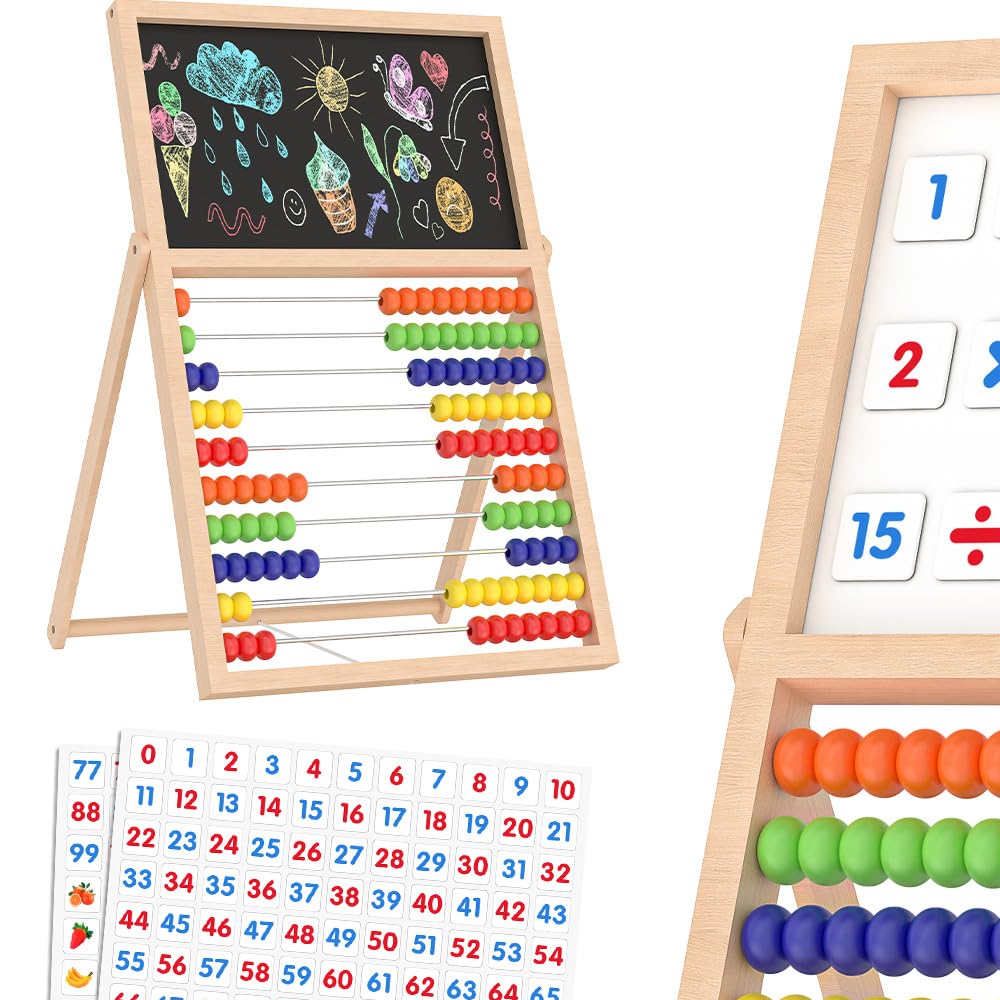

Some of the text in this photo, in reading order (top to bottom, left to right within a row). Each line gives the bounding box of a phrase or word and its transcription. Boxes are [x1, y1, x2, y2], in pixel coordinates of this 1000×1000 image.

[930, 174, 947, 220] 1
[889, 341, 923, 388] 2
[852, 512, 905, 559] 15
[73, 760, 101, 780] 77
[141, 744, 575, 800] 0 1 2 3 4 5 6 7 8 9 10
[71, 802, 100, 822] 88
[137, 786, 570, 841] 11 12 13 14 15 16 17 18 19 20 21
[70, 844, 99, 863] 99
[127, 827, 570, 883] 22 23 24 25 26 27 28 29 30 31 32
[119, 910, 563, 966] 44 45 46 47 48 49 50 51 52 53 54
